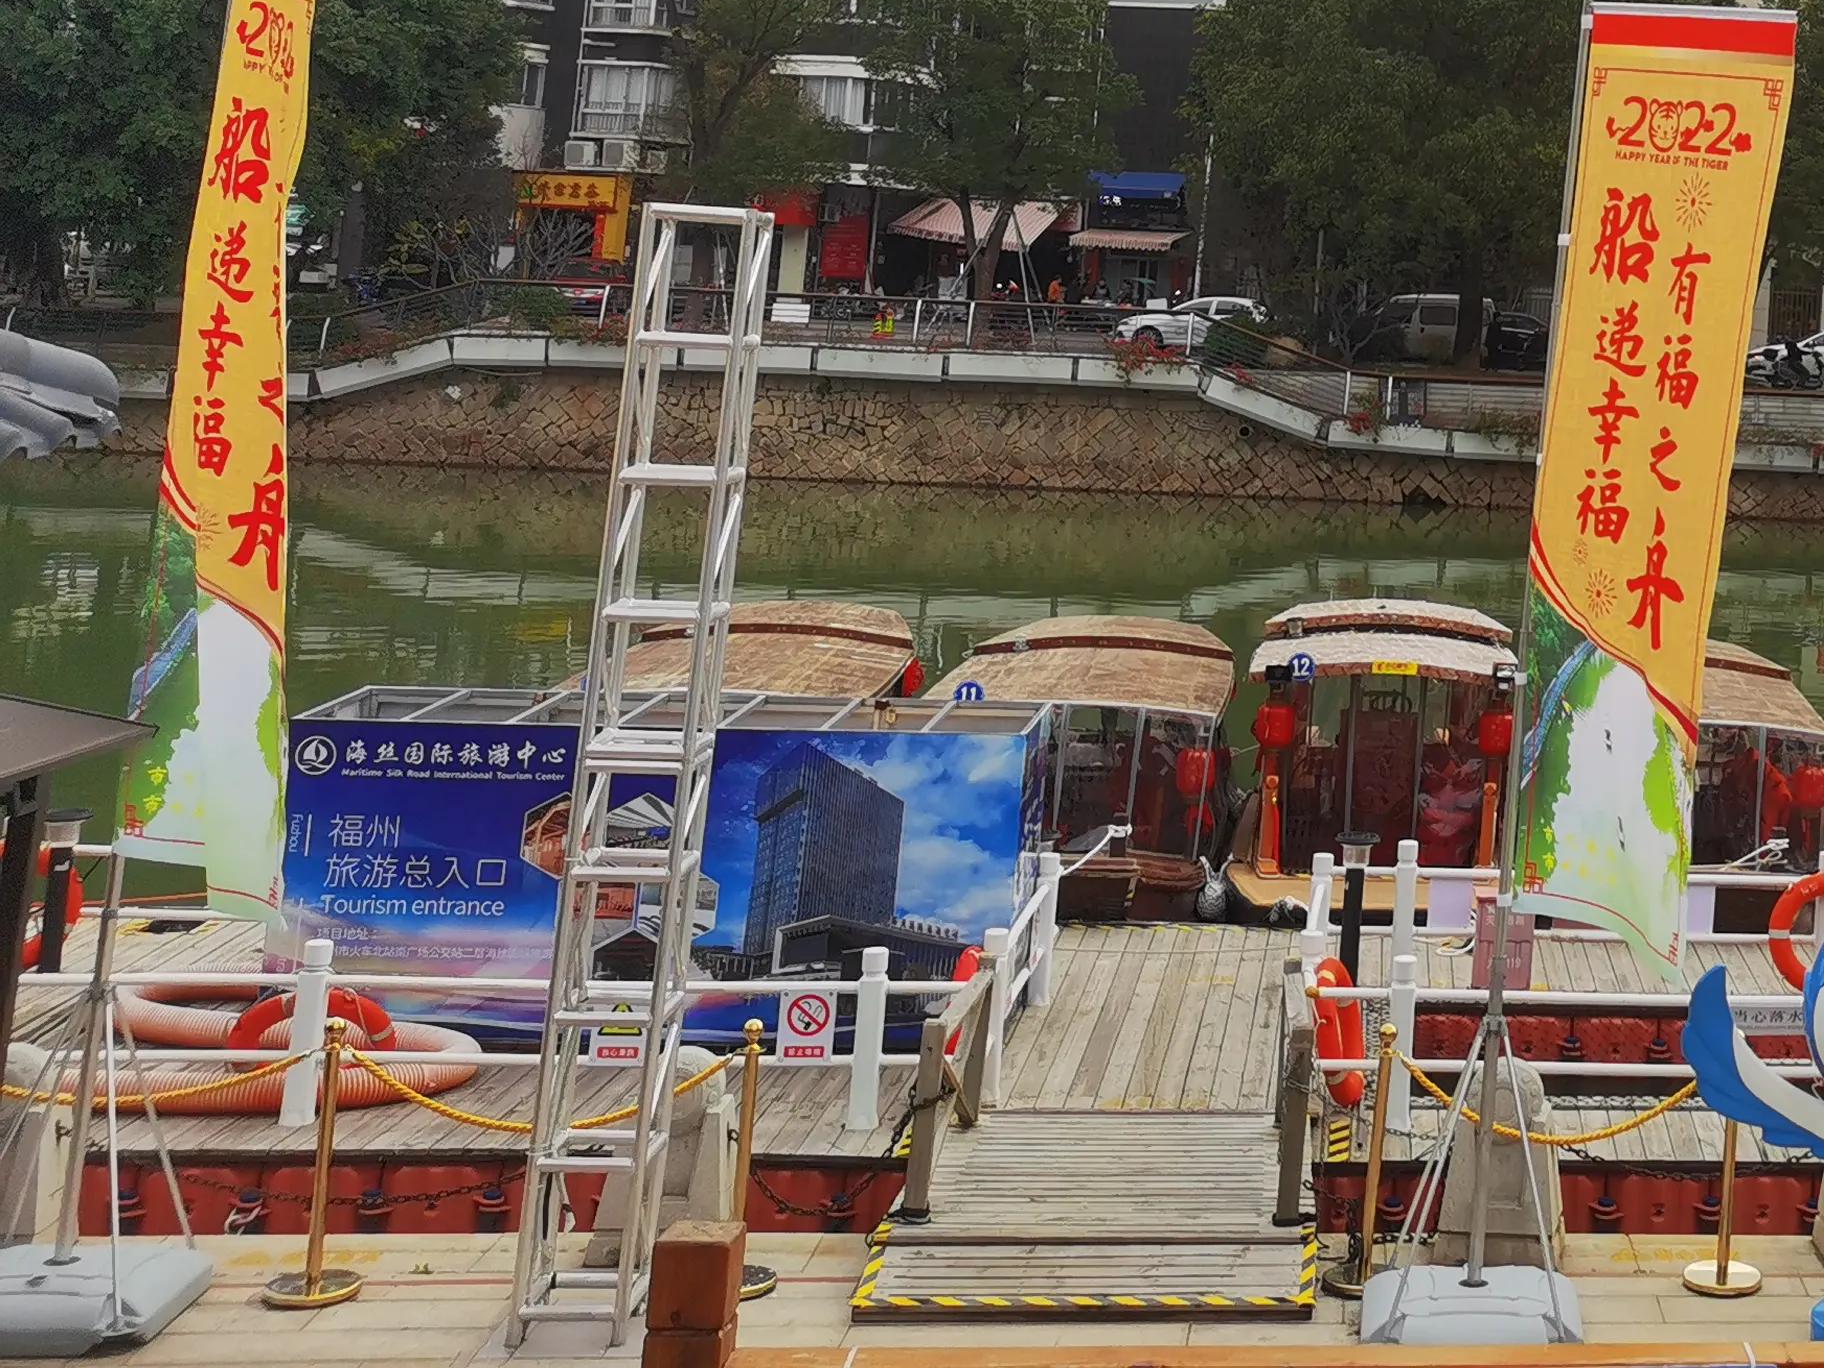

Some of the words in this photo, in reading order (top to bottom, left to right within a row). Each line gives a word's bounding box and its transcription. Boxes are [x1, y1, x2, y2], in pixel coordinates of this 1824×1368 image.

[1617, 96, 1737, 156] 2022
[1615, 149, 1646, 163] HAPPY
[1649, 153, 1672, 166] YEAR
[1684, 156, 1699, 169] THE
[1701, 158, 1729, 171] TIGER
[192, 97, 271, 477] 船递幸福
[1576, 187, 1660, 544] 船递幸福
[1626, 242, 1711, 650] 有福之舟
[1292, 657, 1311, 677] 12
[960, 685, 977, 701] 11
[346, 739, 567, 769] 海丝国际旅游中心
[341, 767, 384, 778] Maritime
[386, 767, 404, 779] Silk
[406, 769, 430, 779] Road
[433, 769, 493, 780] International
[497, 772, 533, 781] Tourism
[535, 772, 565, 781] Center
[288, 813, 304, 852] Fuzhou
[328, 813, 400, 848] 福州
[324, 853, 507, 889] 旅游总入口
[320, 894, 406, 916] Tourism
[412, 897, 505, 917] entrance
